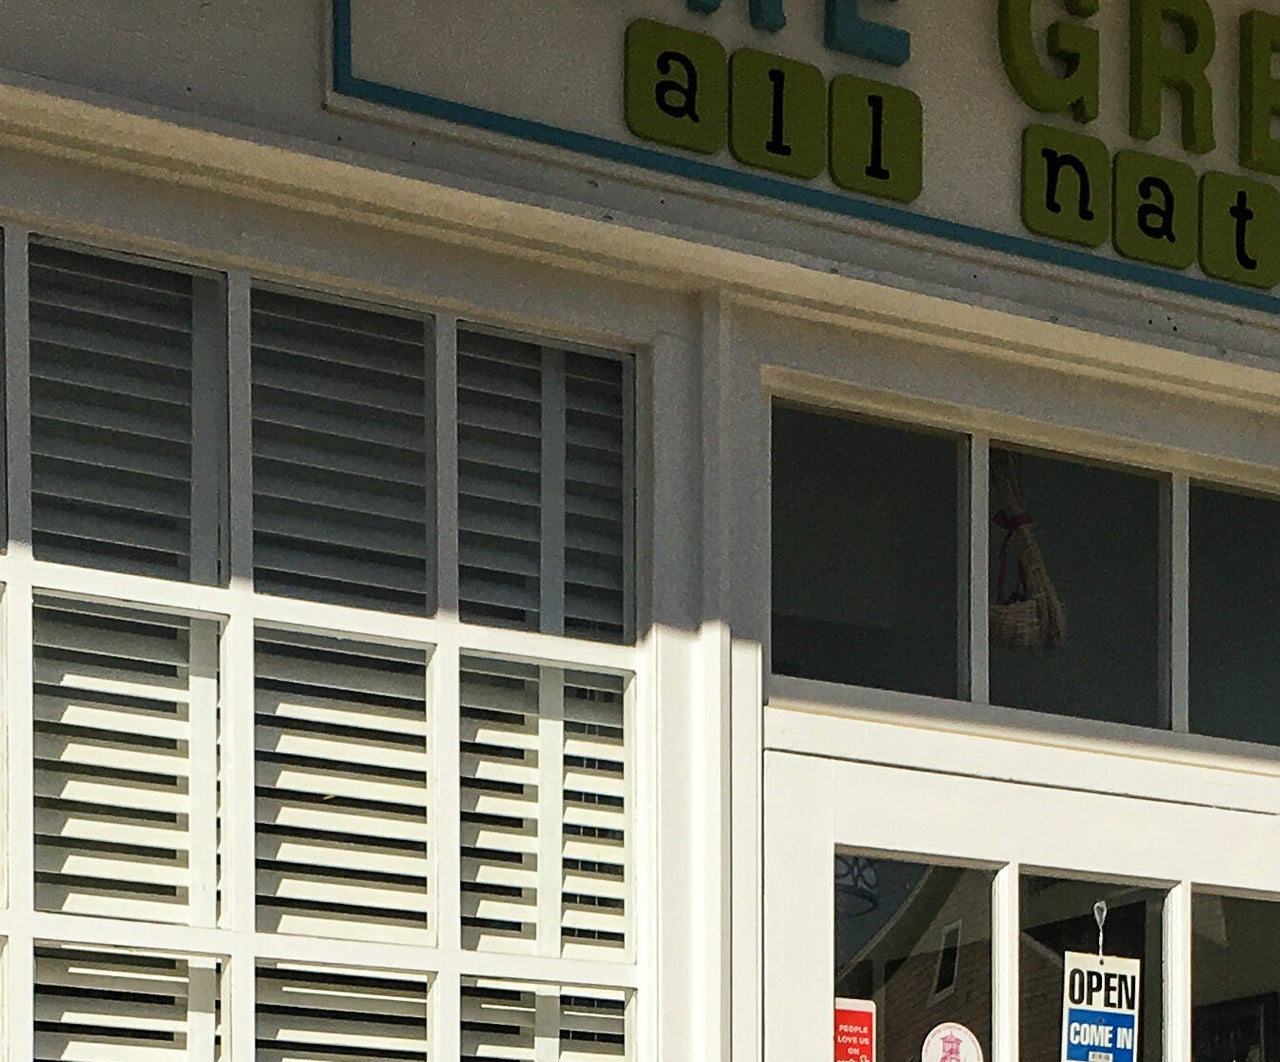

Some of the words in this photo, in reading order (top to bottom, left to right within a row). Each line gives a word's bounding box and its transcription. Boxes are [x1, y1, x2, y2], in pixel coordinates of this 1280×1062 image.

[654, 50, 891, 180] all
[1068, 967, 1136, 1010] OPEN
[838, 1024, 868, 1034] PEOPLE
[1069, 1022, 1113, 1048] COME
[1116, 1026, 1133, 1050] IN
[837, 1035, 858, 1044] LOVE
[858, 1036, 869, 1045] US
[847, 1047, 860, 1056] ON
